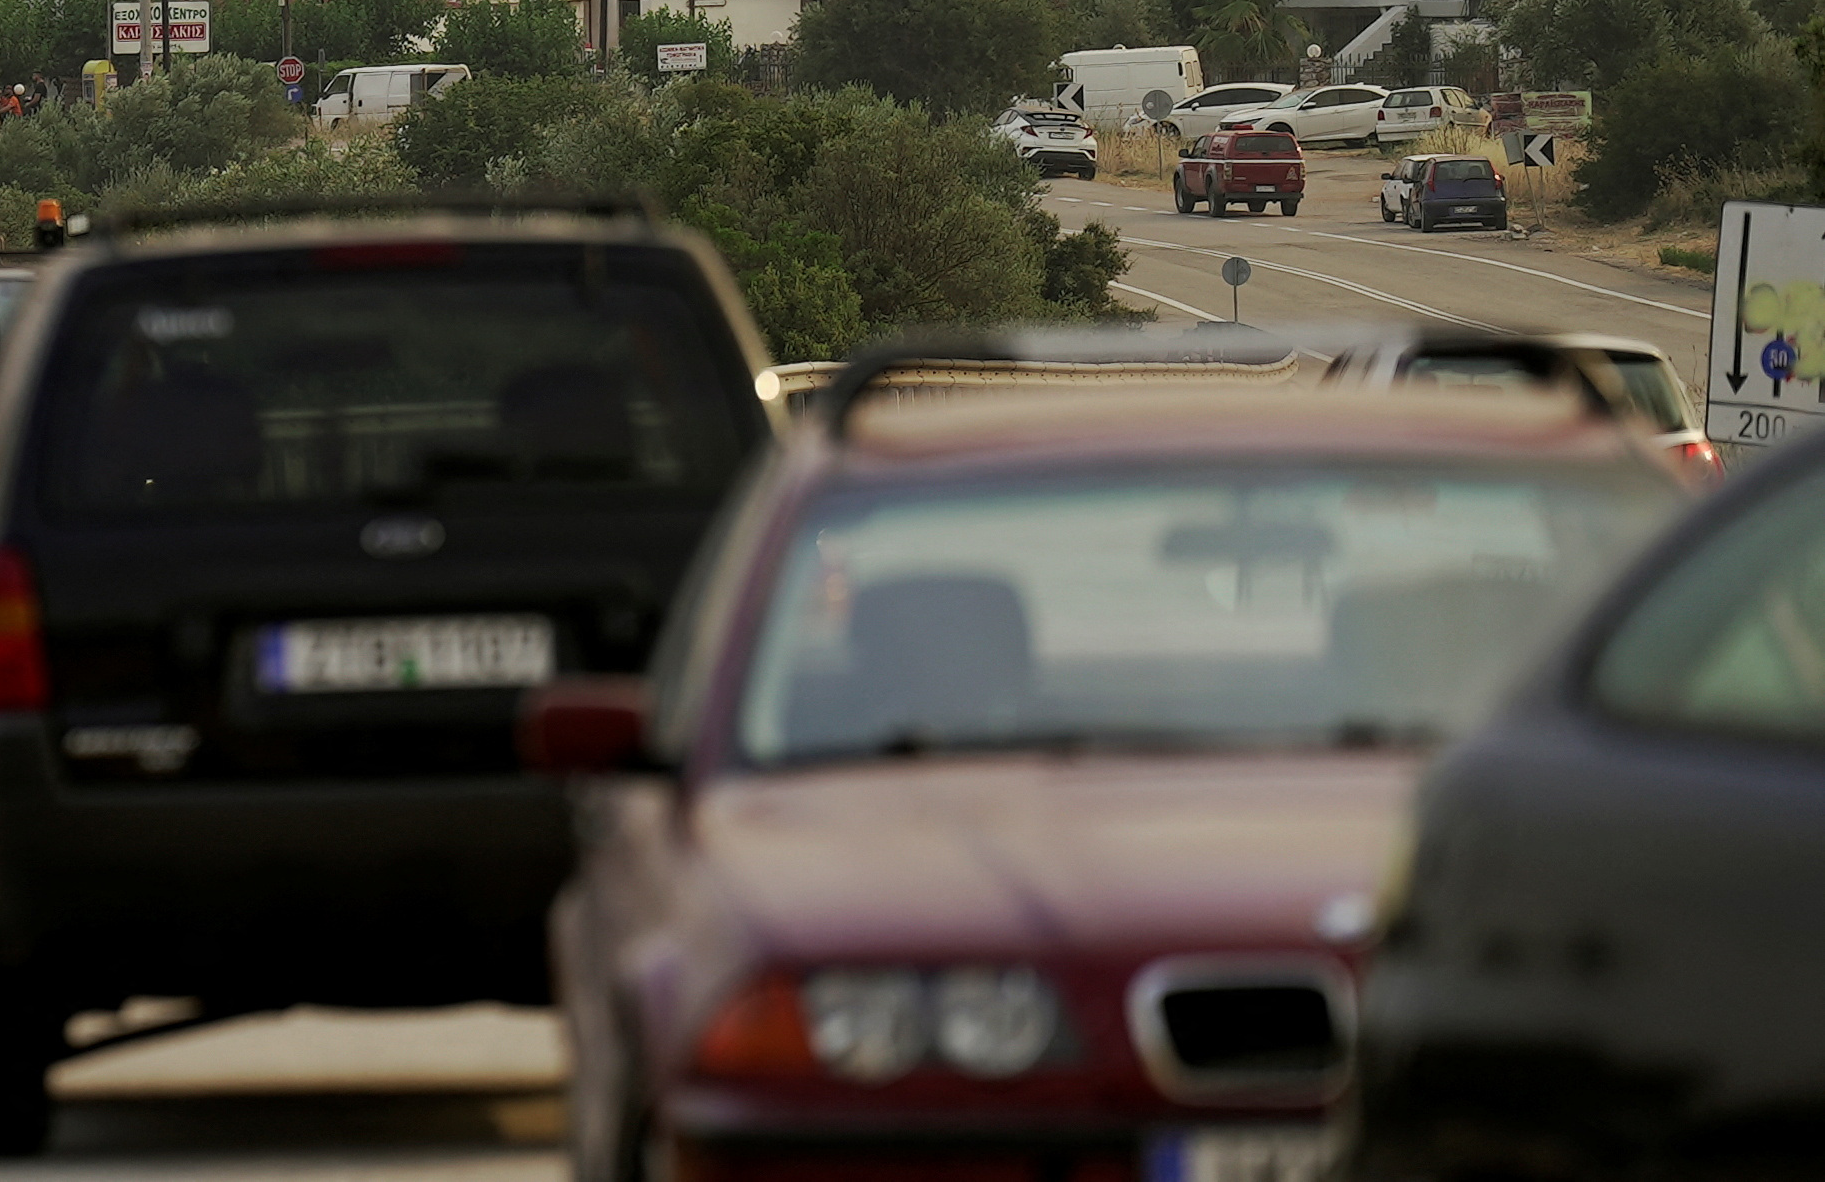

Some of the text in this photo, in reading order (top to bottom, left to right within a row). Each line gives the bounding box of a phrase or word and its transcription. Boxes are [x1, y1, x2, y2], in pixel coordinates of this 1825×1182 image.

[115, 6, 161, 20] ΕΞΟΧΟ
[279, 64, 302, 78] STOP
[1738, 410, 1787, 439] 200
